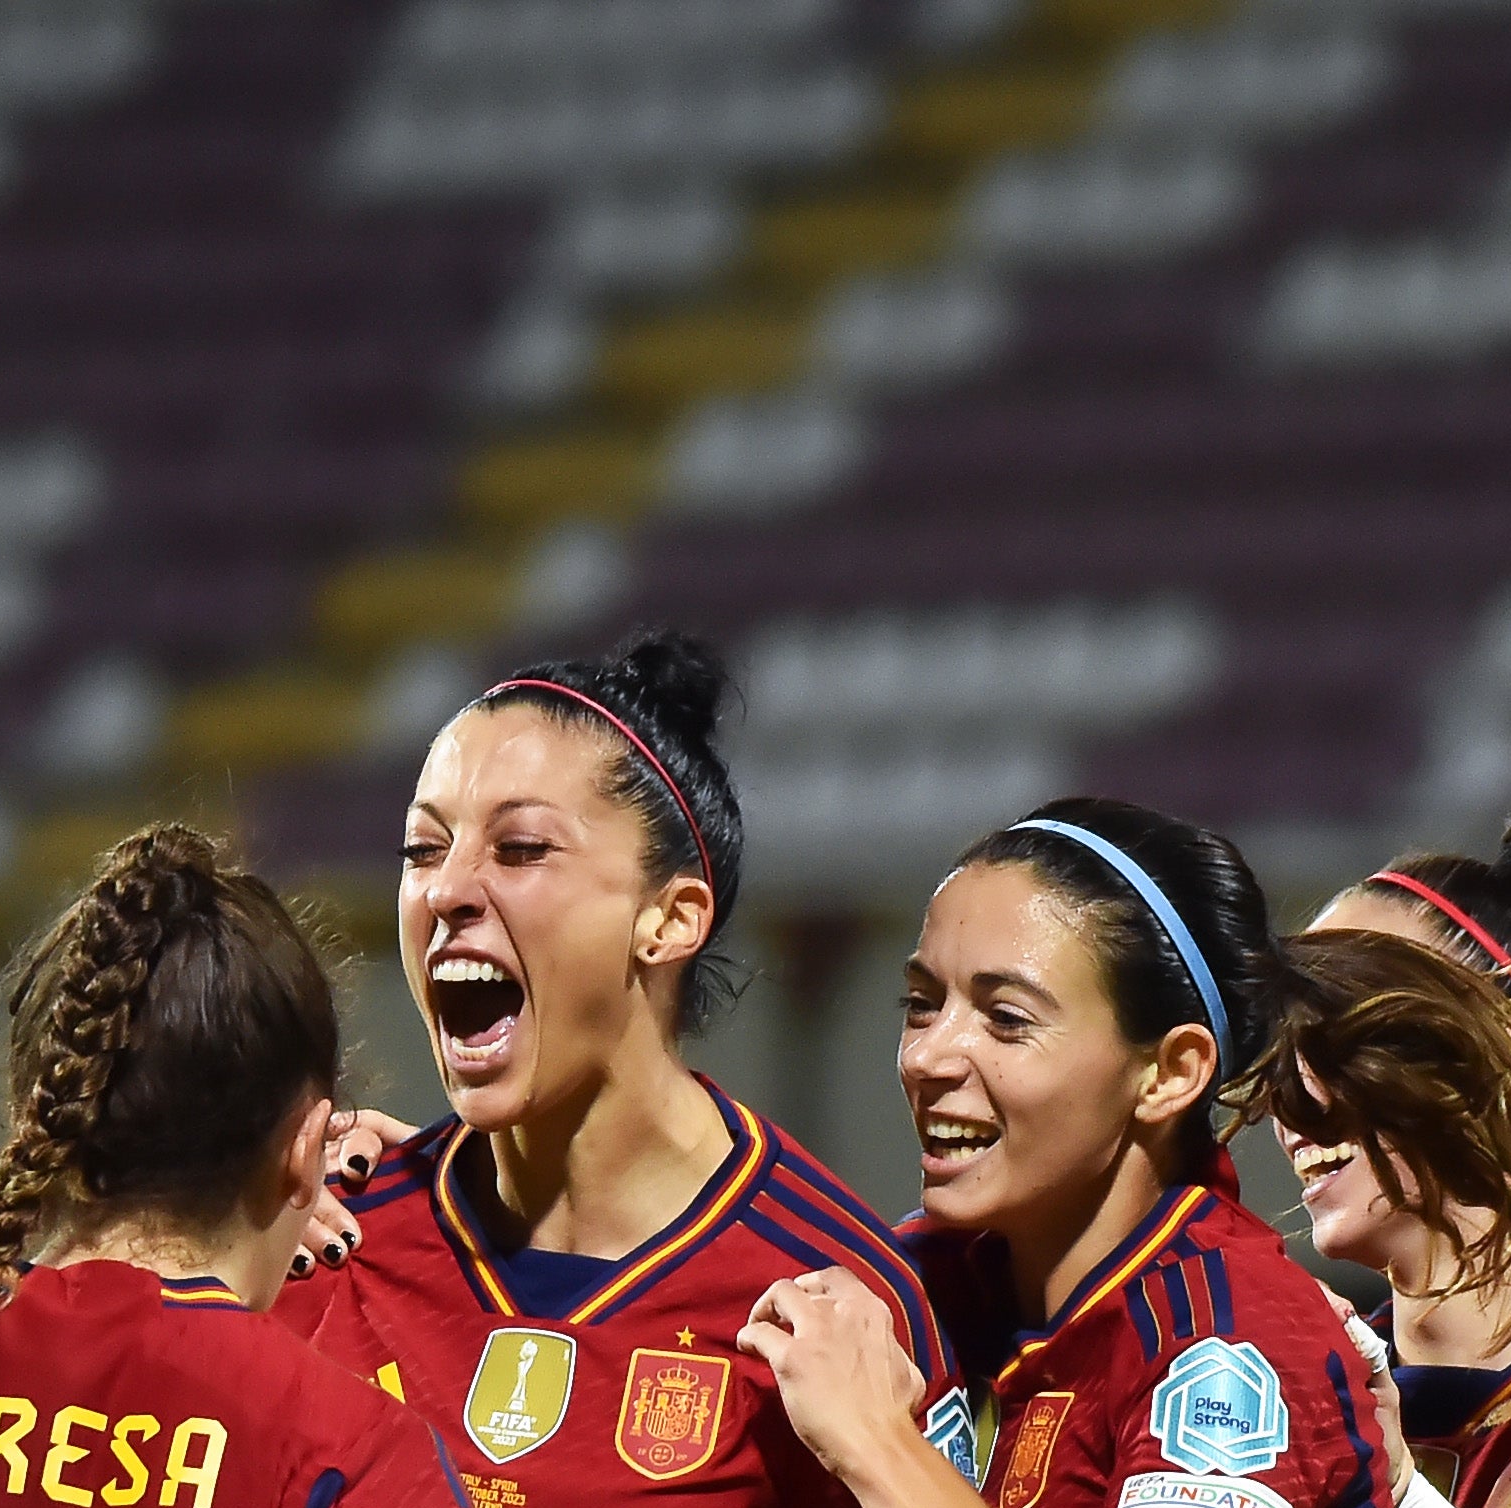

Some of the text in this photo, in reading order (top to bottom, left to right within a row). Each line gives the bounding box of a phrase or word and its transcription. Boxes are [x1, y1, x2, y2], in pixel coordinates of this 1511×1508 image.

[1195, 1397, 1232, 1415] Play
[489, 1411, 532, 1431] FIFA
[1194, 1413, 1251, 1434] Strong
[460, 1473, 482, 1487] TALY
[1128, 1475, 1165, 1489] UEFA
